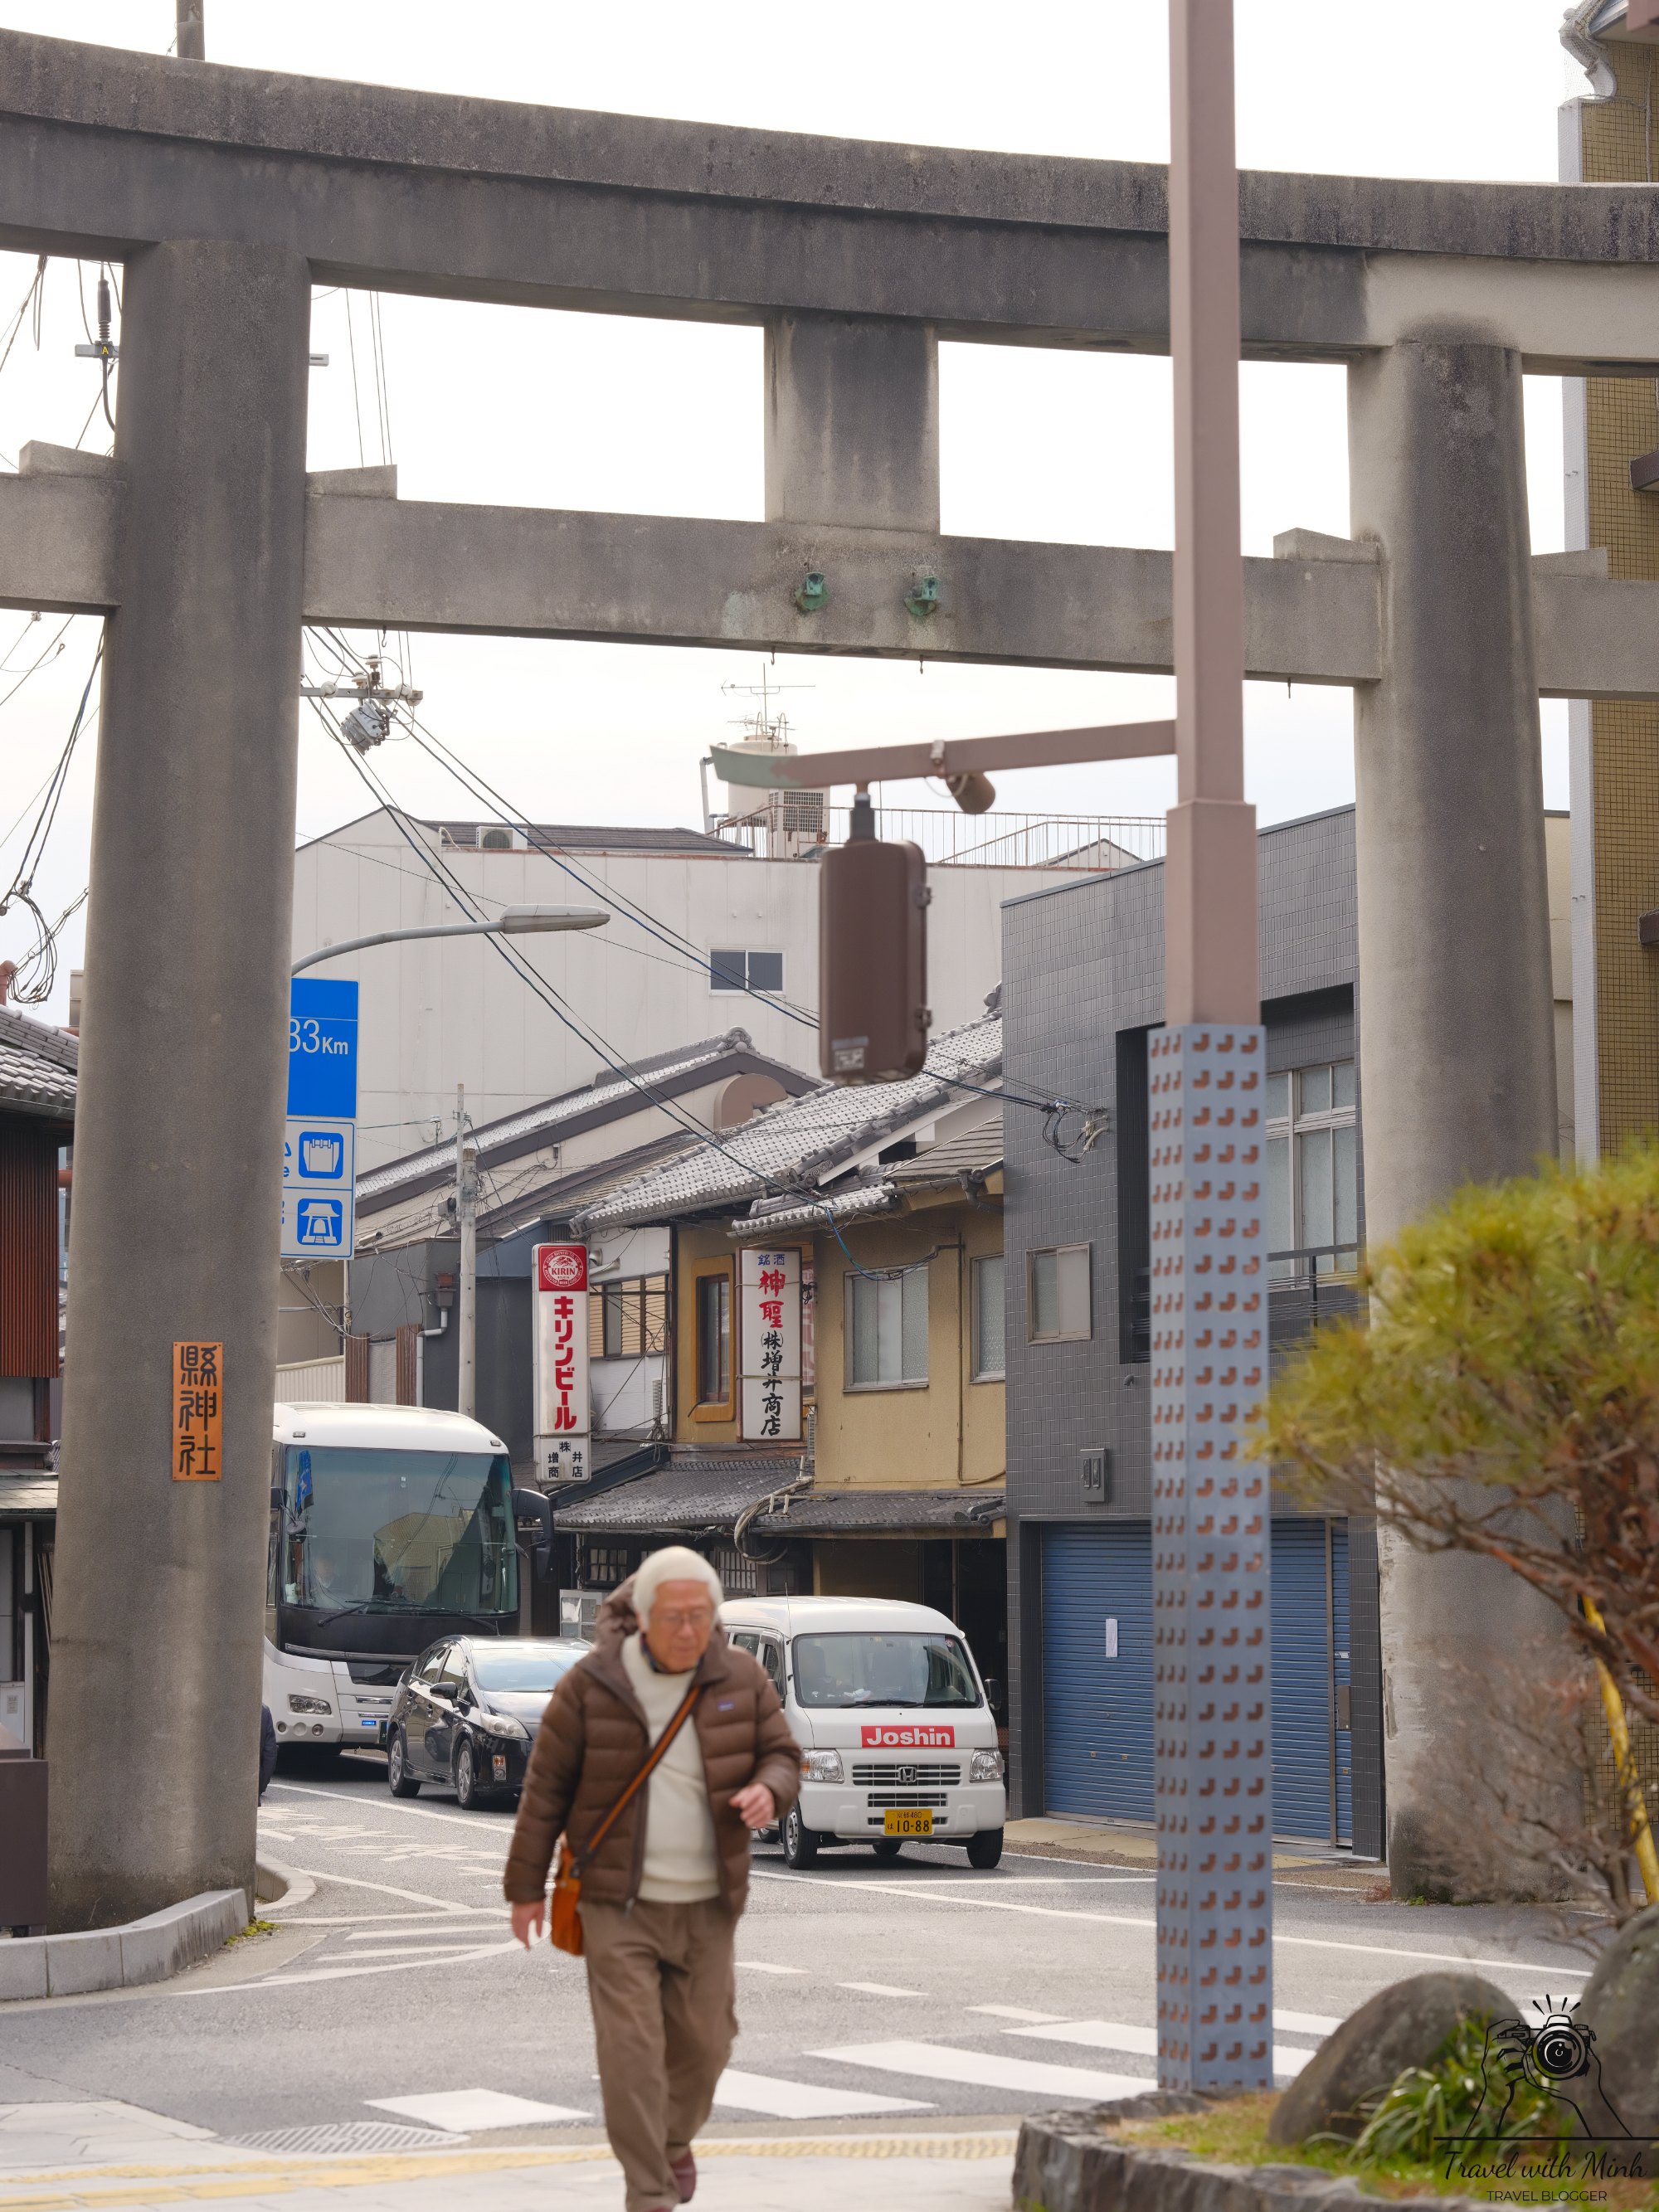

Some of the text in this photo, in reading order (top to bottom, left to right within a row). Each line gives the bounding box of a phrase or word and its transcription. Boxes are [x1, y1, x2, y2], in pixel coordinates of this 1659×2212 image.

[552, 1267, 576, 1276] KIRIN
[757, 1269, 786, 1329] 神聖
[554, 1296, 577, 1431] キリンビール
[867, 1727, 951, 1746] Joshin
[897, 1820, 930, 1833] 10-88
